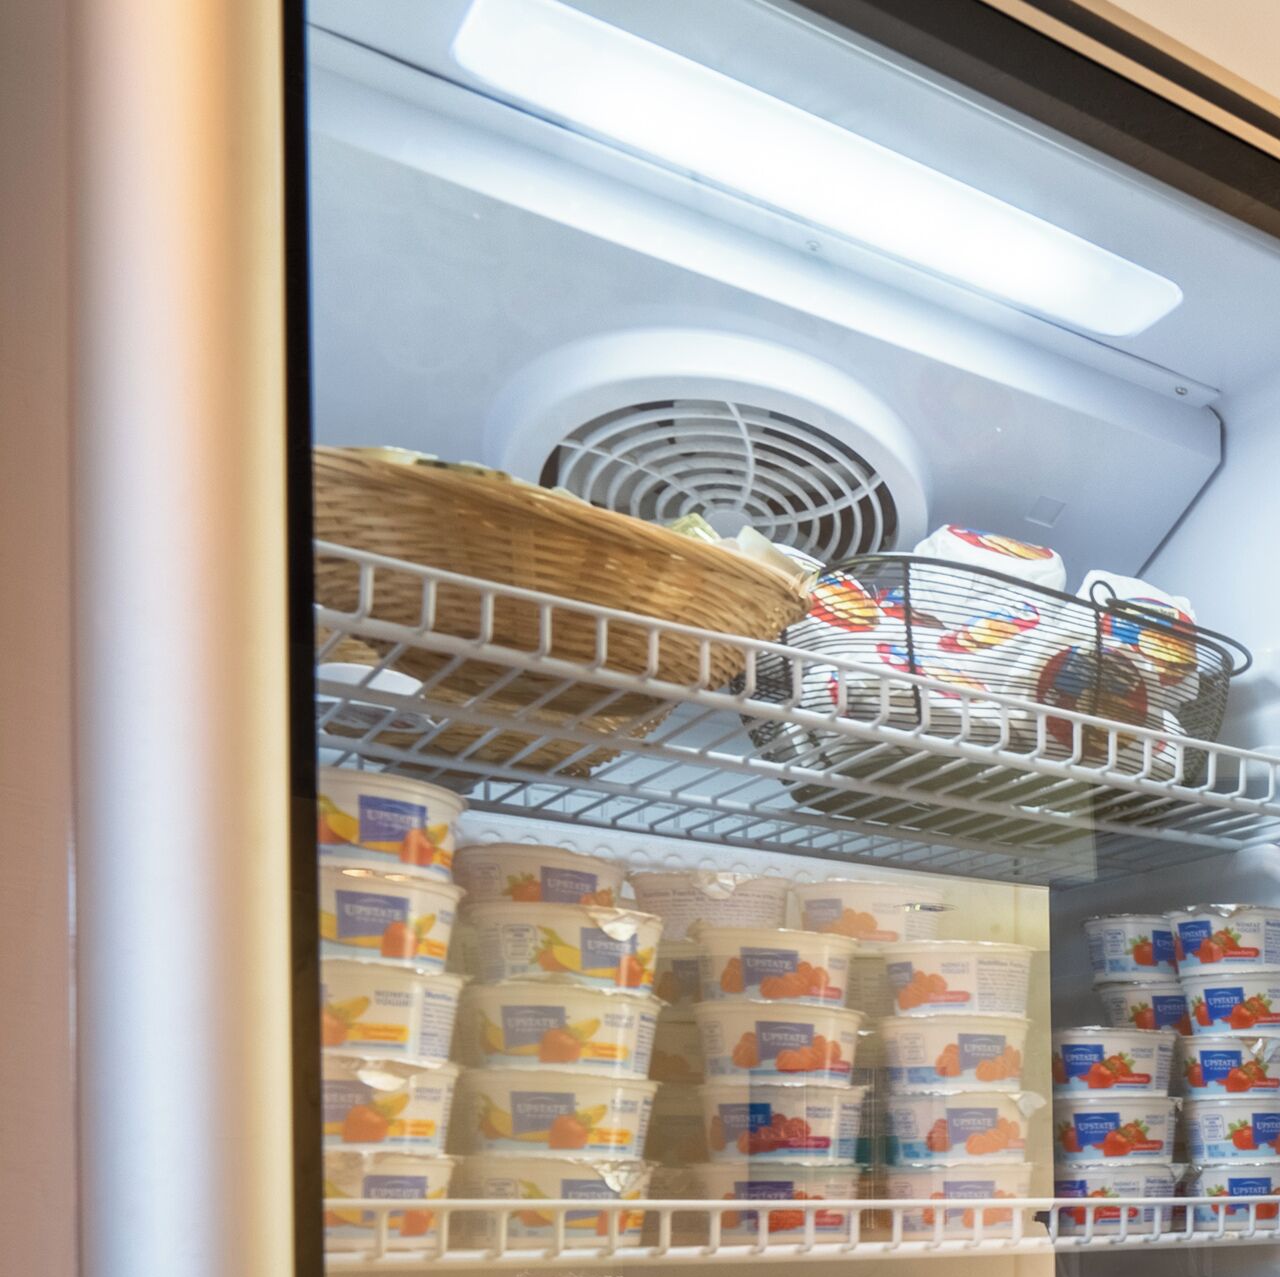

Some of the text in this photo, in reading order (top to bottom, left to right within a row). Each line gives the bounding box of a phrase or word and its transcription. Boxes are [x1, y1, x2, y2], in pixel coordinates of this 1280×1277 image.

[1207, 996, 1240, 1006] UPSTATE
[762, 1031, 809, 1044] UPSTATE
[1065, 1052, 1100, 1063] UPSTATE
[1203, 1058, 1238, 1068] UPSTATE
[1078, 1121, 1116, 1132] UPSTATE
[1232, 1185, 1268, 1195] UPSTATE
